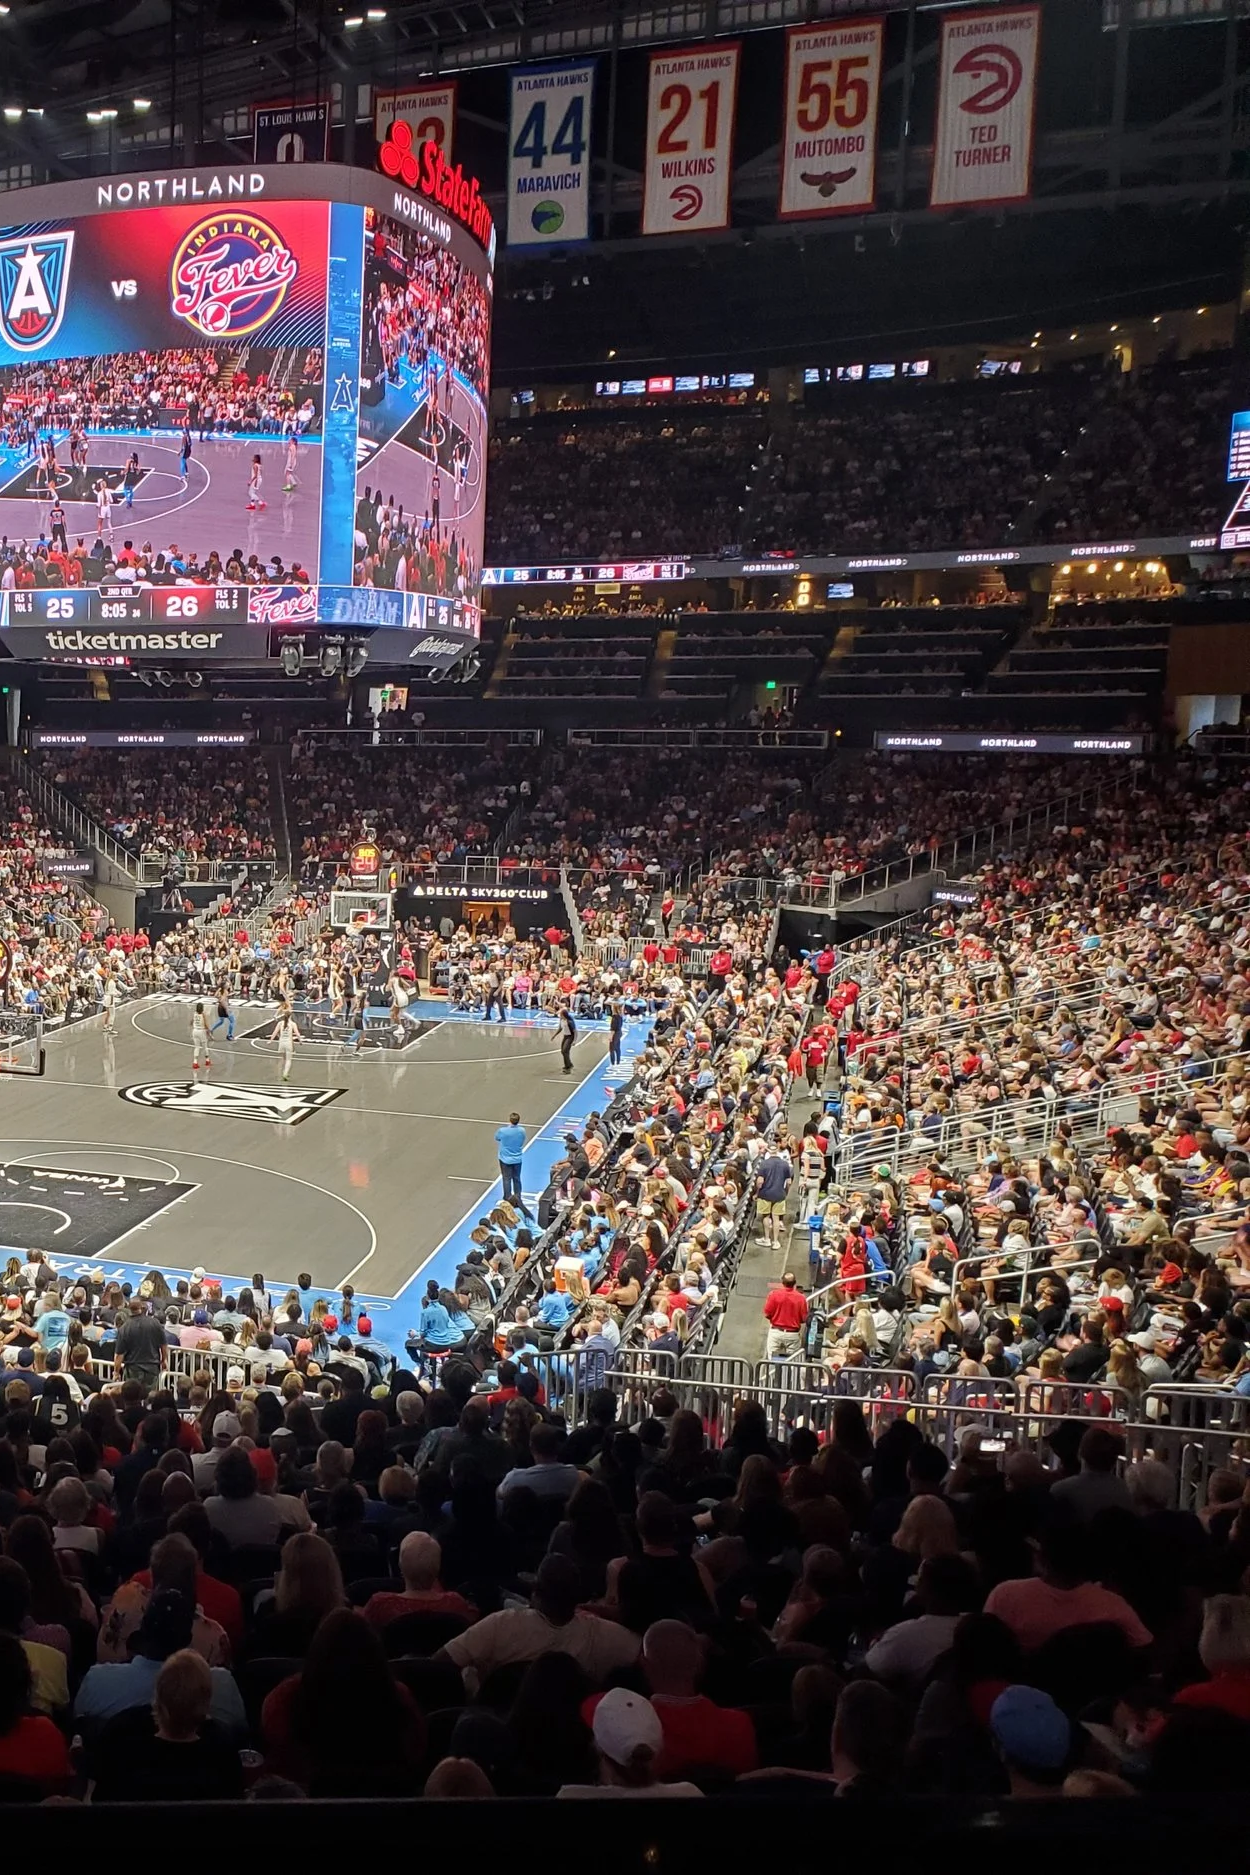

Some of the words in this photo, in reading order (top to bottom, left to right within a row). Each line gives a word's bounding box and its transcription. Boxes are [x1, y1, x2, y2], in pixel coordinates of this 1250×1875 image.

[948, 23, 994, 38] ATLANTA
[996, 17, 1033, 33] HAWKS
[795, 36, 838, 52] ATLANTA
[840, 30, 876, 45] HAWKS
[655, 60, 695, 76] ATLANTA
[697, 56, 731, 71] HAWKS
[517, 76, 555, 92] ATLANTA
[557, 72, 589, 88] HAWKS
[797, 55, 869, 132] 55
[380, 97, 417, 114] ATLANTA
[418, 94, 449, 109] HAWKS
[657, 80, 721, 154] 21
[513, 96, 587, 169] 44
[970, 125, 998, 144] TED
[794, 135, 865, 159] MUTOMBO
[954, 146, 1011, 167] TURNER
[661, 158, 716, 179] WILKINS
[98, 174, 266, 204] NORTHLAND
[516, 172, 581, 194] MARAVICH
[394, 191, 452, 243] NORTHLAND
[186, 221, 272, 257] INDIANA
[111, 280, 138, 297] VS
[173, 243, 298, 317] Fever
[513, 571, 529, 581] 25
[547, 570, 566, 580] 8:05
[598, 567, 615, 578] 26
[14, 593, 25, 603] FLS
[28, 593, 33, 602] 1
[215, 590, 228, 599] FLS
[232, 590, 238, 599] 2
[215, 600, 230, 609] TOL
[232, 600, 238, 609] 5
[14, 603, 27, 612] TOL
[46, 598, 74, 618] 25
[101, 603, 127, 618] 8:05
[166, 596, 198, 617] 26
[46, 631, 223, 651] ticketmaster
[40, 735, 87, 743] NORTHLAND
[117, 735, 165, 743] NORTHLAND
[197, 735, 245, 743] NORTHLAND
[886, 737, 943, 746] NORTHLAND
[980, 738, 1037, 748] NORTHLAND
[1073, 740, 1132, 749] NORTHLAND
[354, 856, 375, 871] 24
[426, 886, 468, 897] DELTA
[51, 1403, 68, 1426] 5
